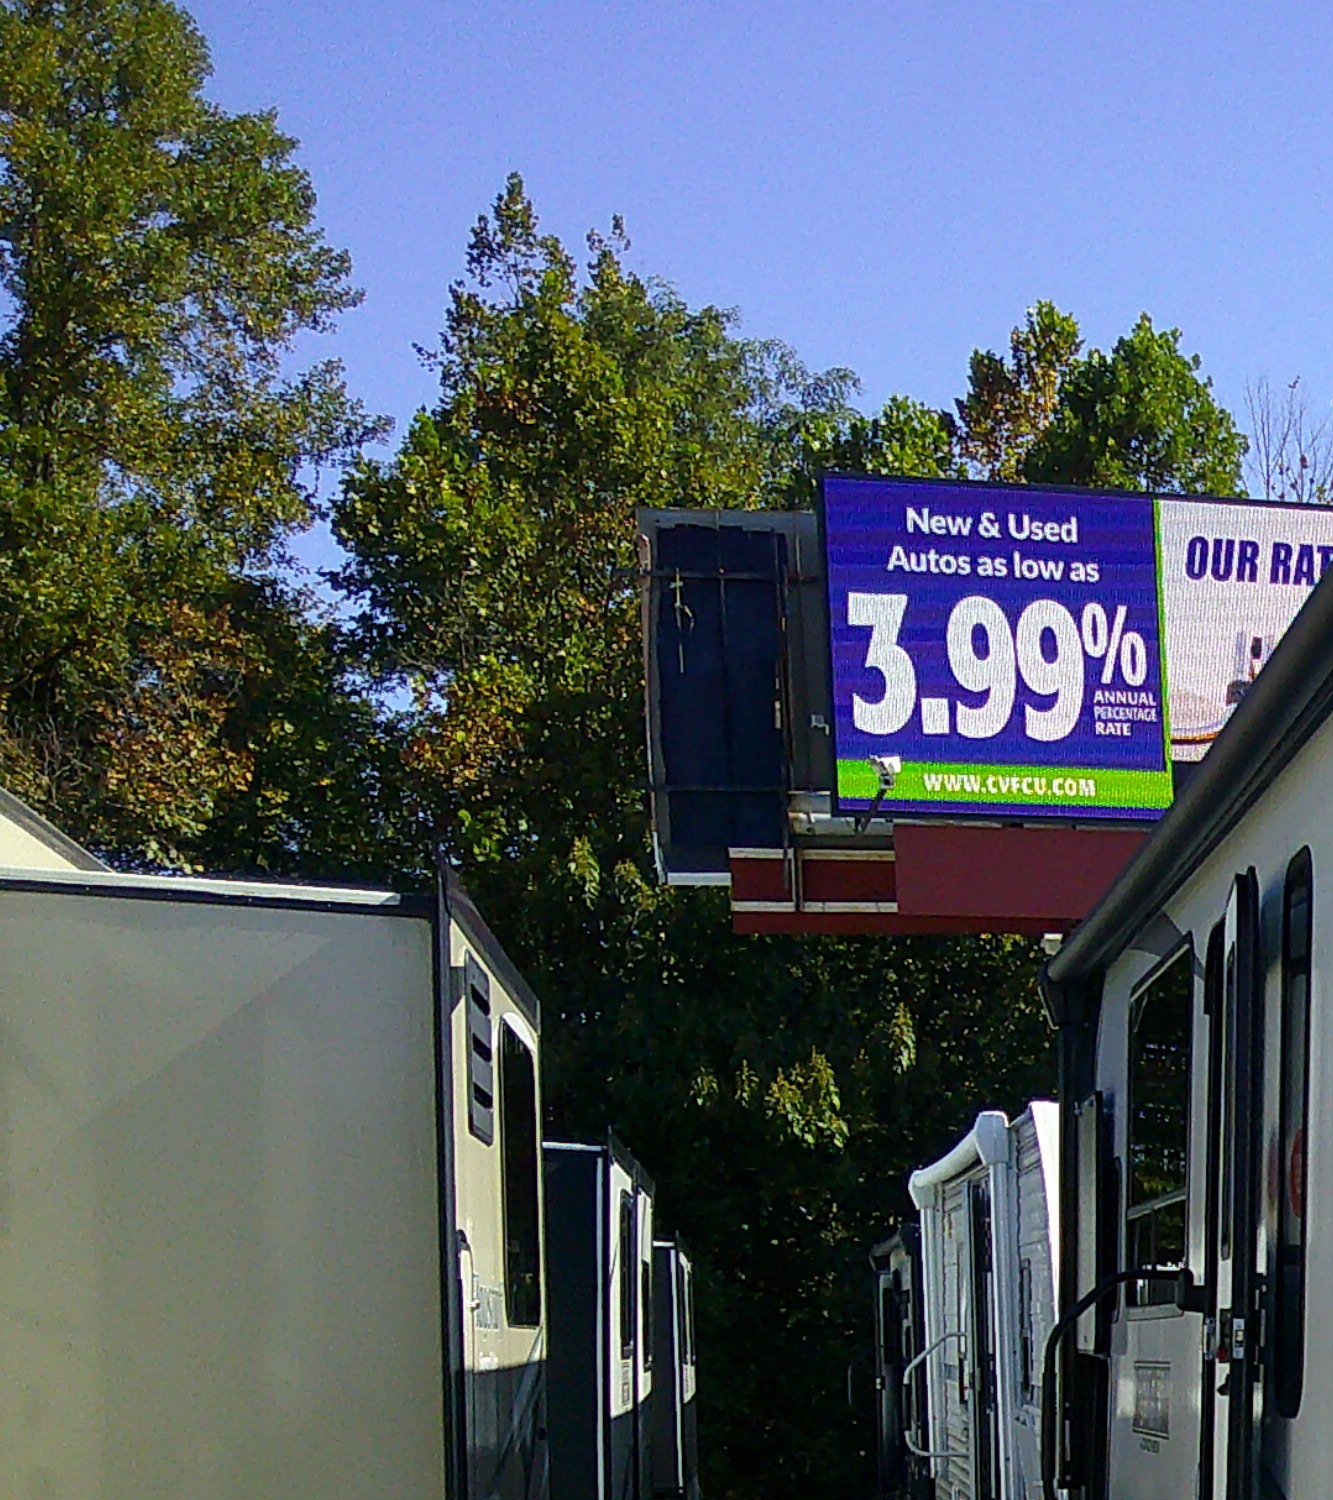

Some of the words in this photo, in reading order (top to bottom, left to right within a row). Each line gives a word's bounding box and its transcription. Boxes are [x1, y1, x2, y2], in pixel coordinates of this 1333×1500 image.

[906, 507, 970, 536] New
[978, 512, 1002, 538] &
[1009, 513, 1078, 543] Used
[887, 545, 971, 575] Autos
[977, 556, 1008, 577] as
[1014, 550, 1064, 581] low
[1069, 562, 1100, 583] as
[1185, 535, 1260, 583] OUR
[1094, 691, 1156, 706] ANNUAL
[1094, 706, 1158, 723] PERCENTAGE
[1095, 722, 1131, 736] RATE
